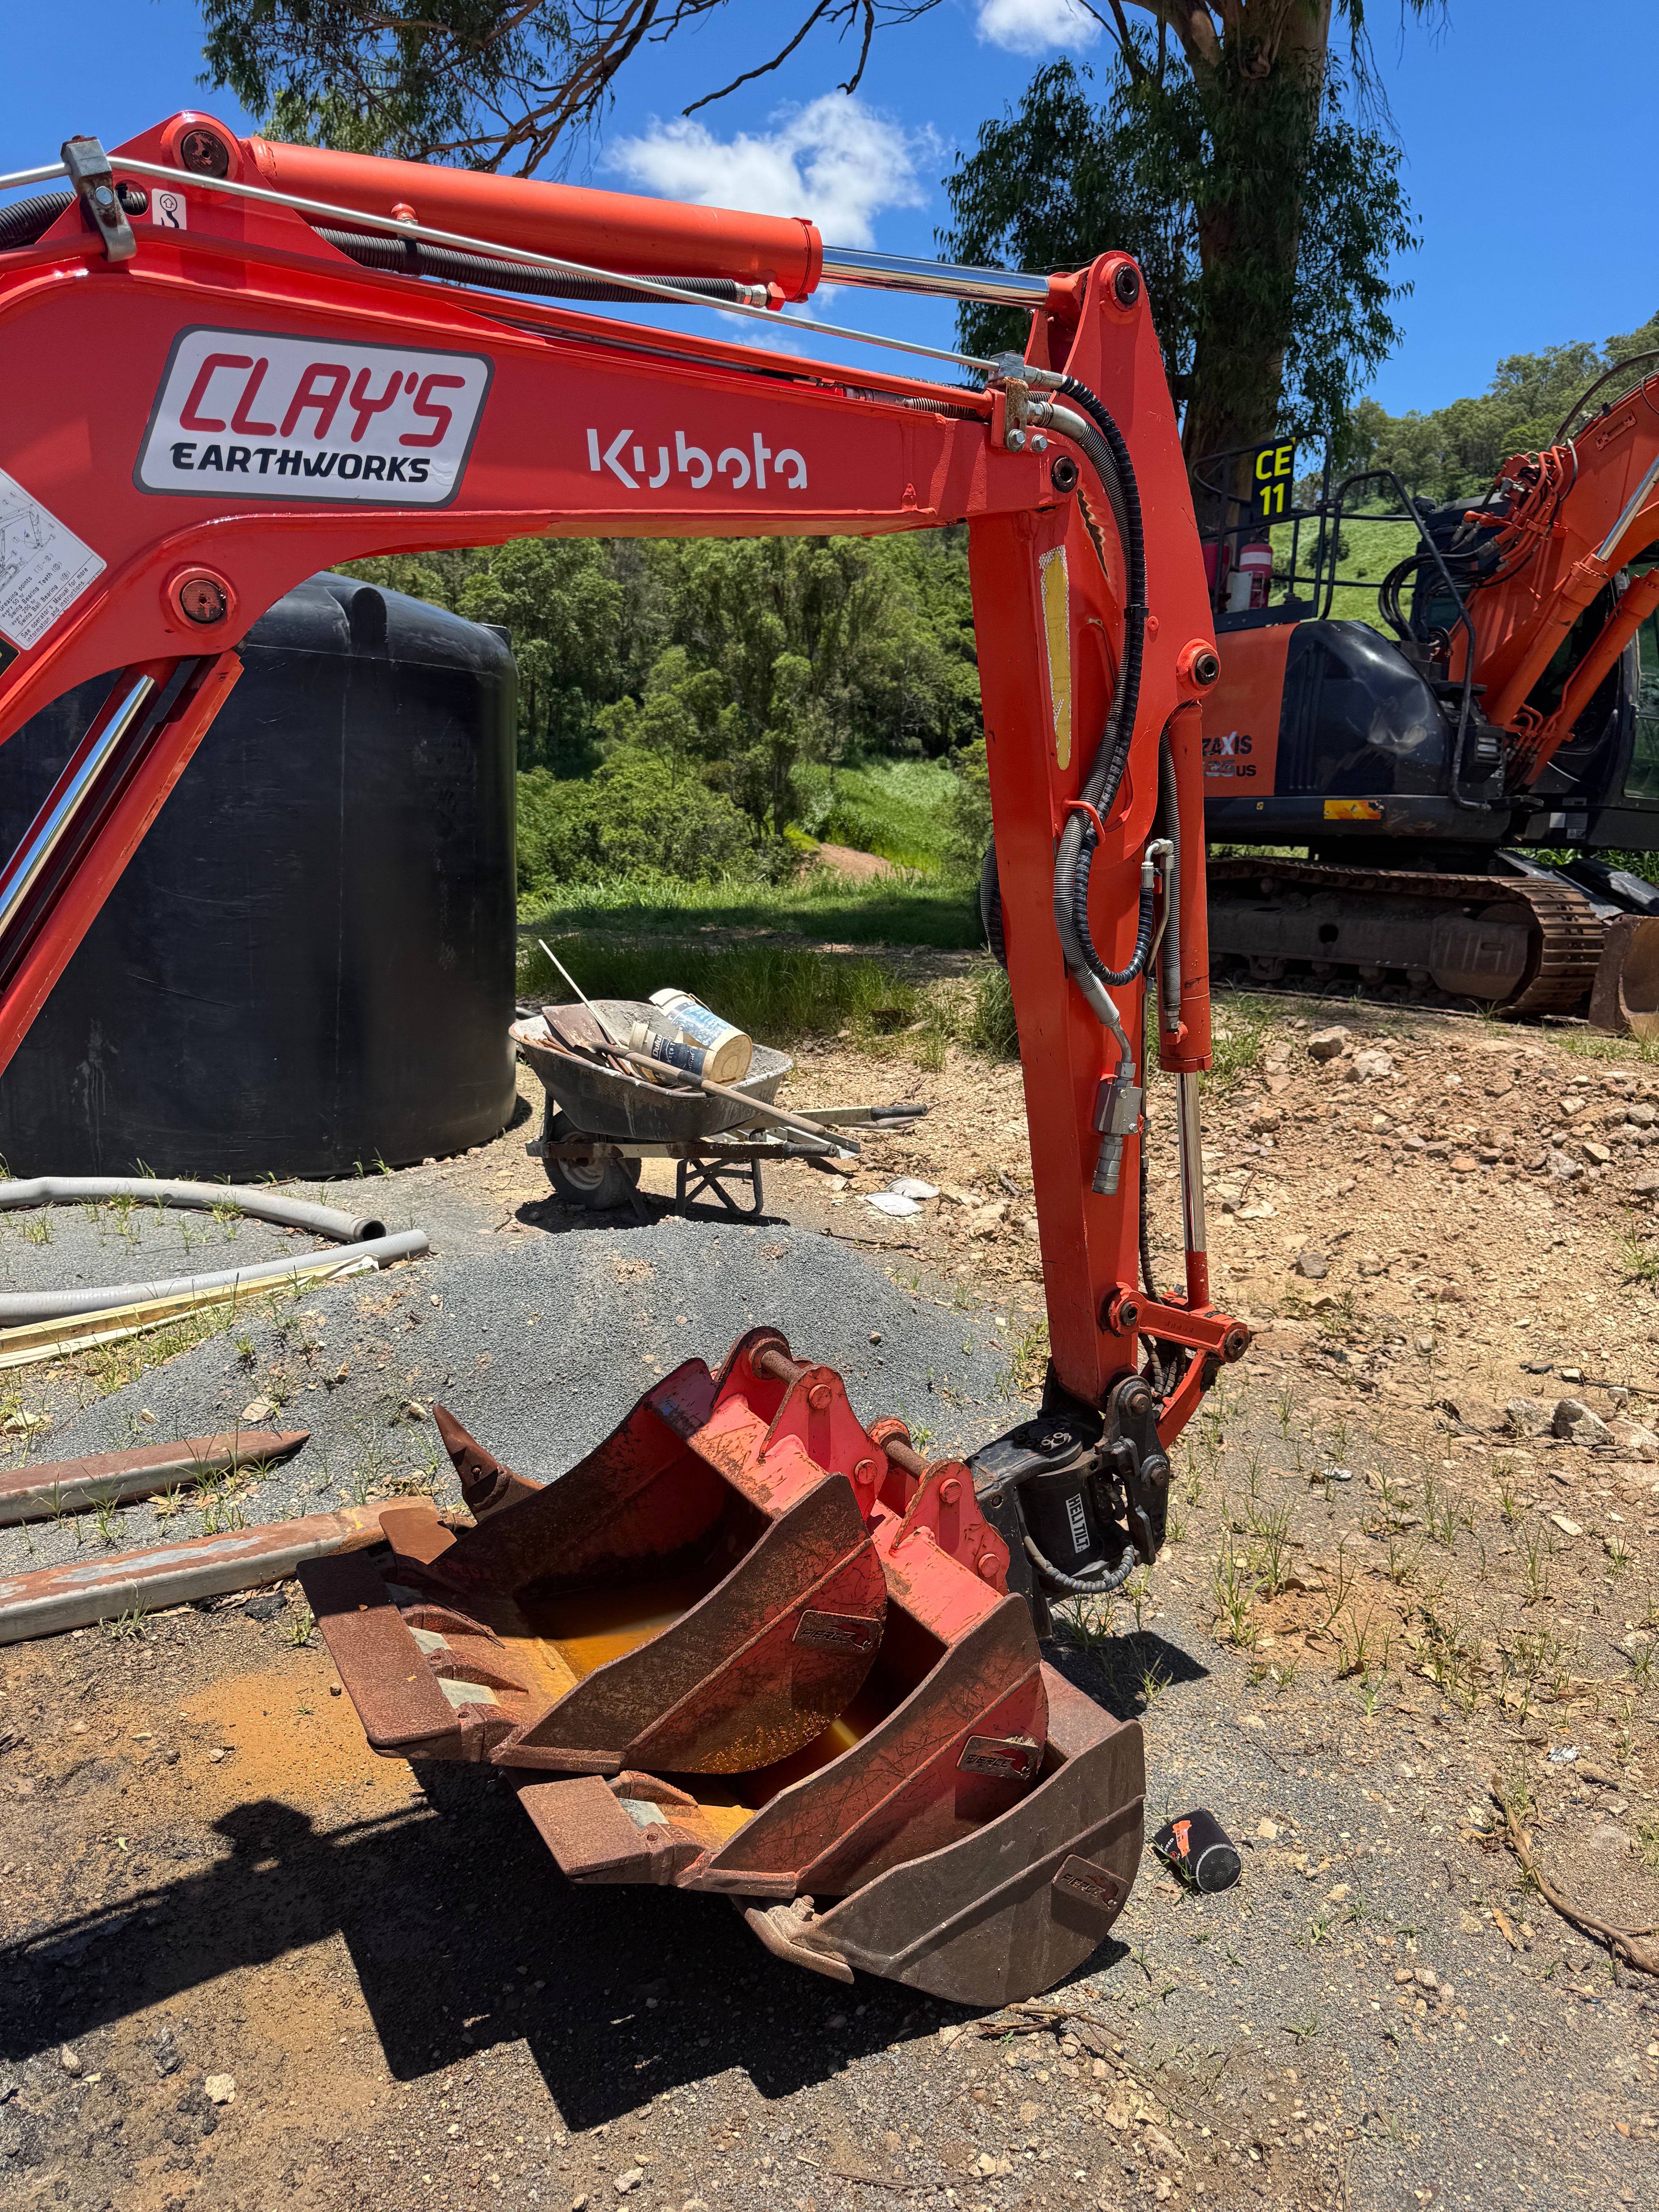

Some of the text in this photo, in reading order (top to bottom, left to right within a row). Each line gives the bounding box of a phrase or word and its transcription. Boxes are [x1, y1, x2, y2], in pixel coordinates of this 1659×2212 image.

[179, 353, 465, 448] CLAY'S
[170, 442, 431, 483] EARTHWORKS
[587, 429, 807, 489] Kubota
[1255, 445, 1293, 480] CE
[1259, 483, 1285, 516] 11
[8, 604, 23, 618] Swing
[21, 586, 40, 604] Bearing
[38, 572, 53, 586] Teeth
[18, 576, 32, 591] points
[17, 612, 32, 626] Swing
[31, 601, 41, 612] Ball
[40, 585, 58, 602] Bearing
[21, 567, 88, 638] See operator's Manual for more
[22, 604, 31, 614] 200
[26, 617, 51, 642] information
[51, 606, 60, 617] and
[1202, 731, 1252, 756] ZAXIS
[1068, 1495, 1084, 1525] HELI
[964, 1754, 1013, 1768] FIERCE
